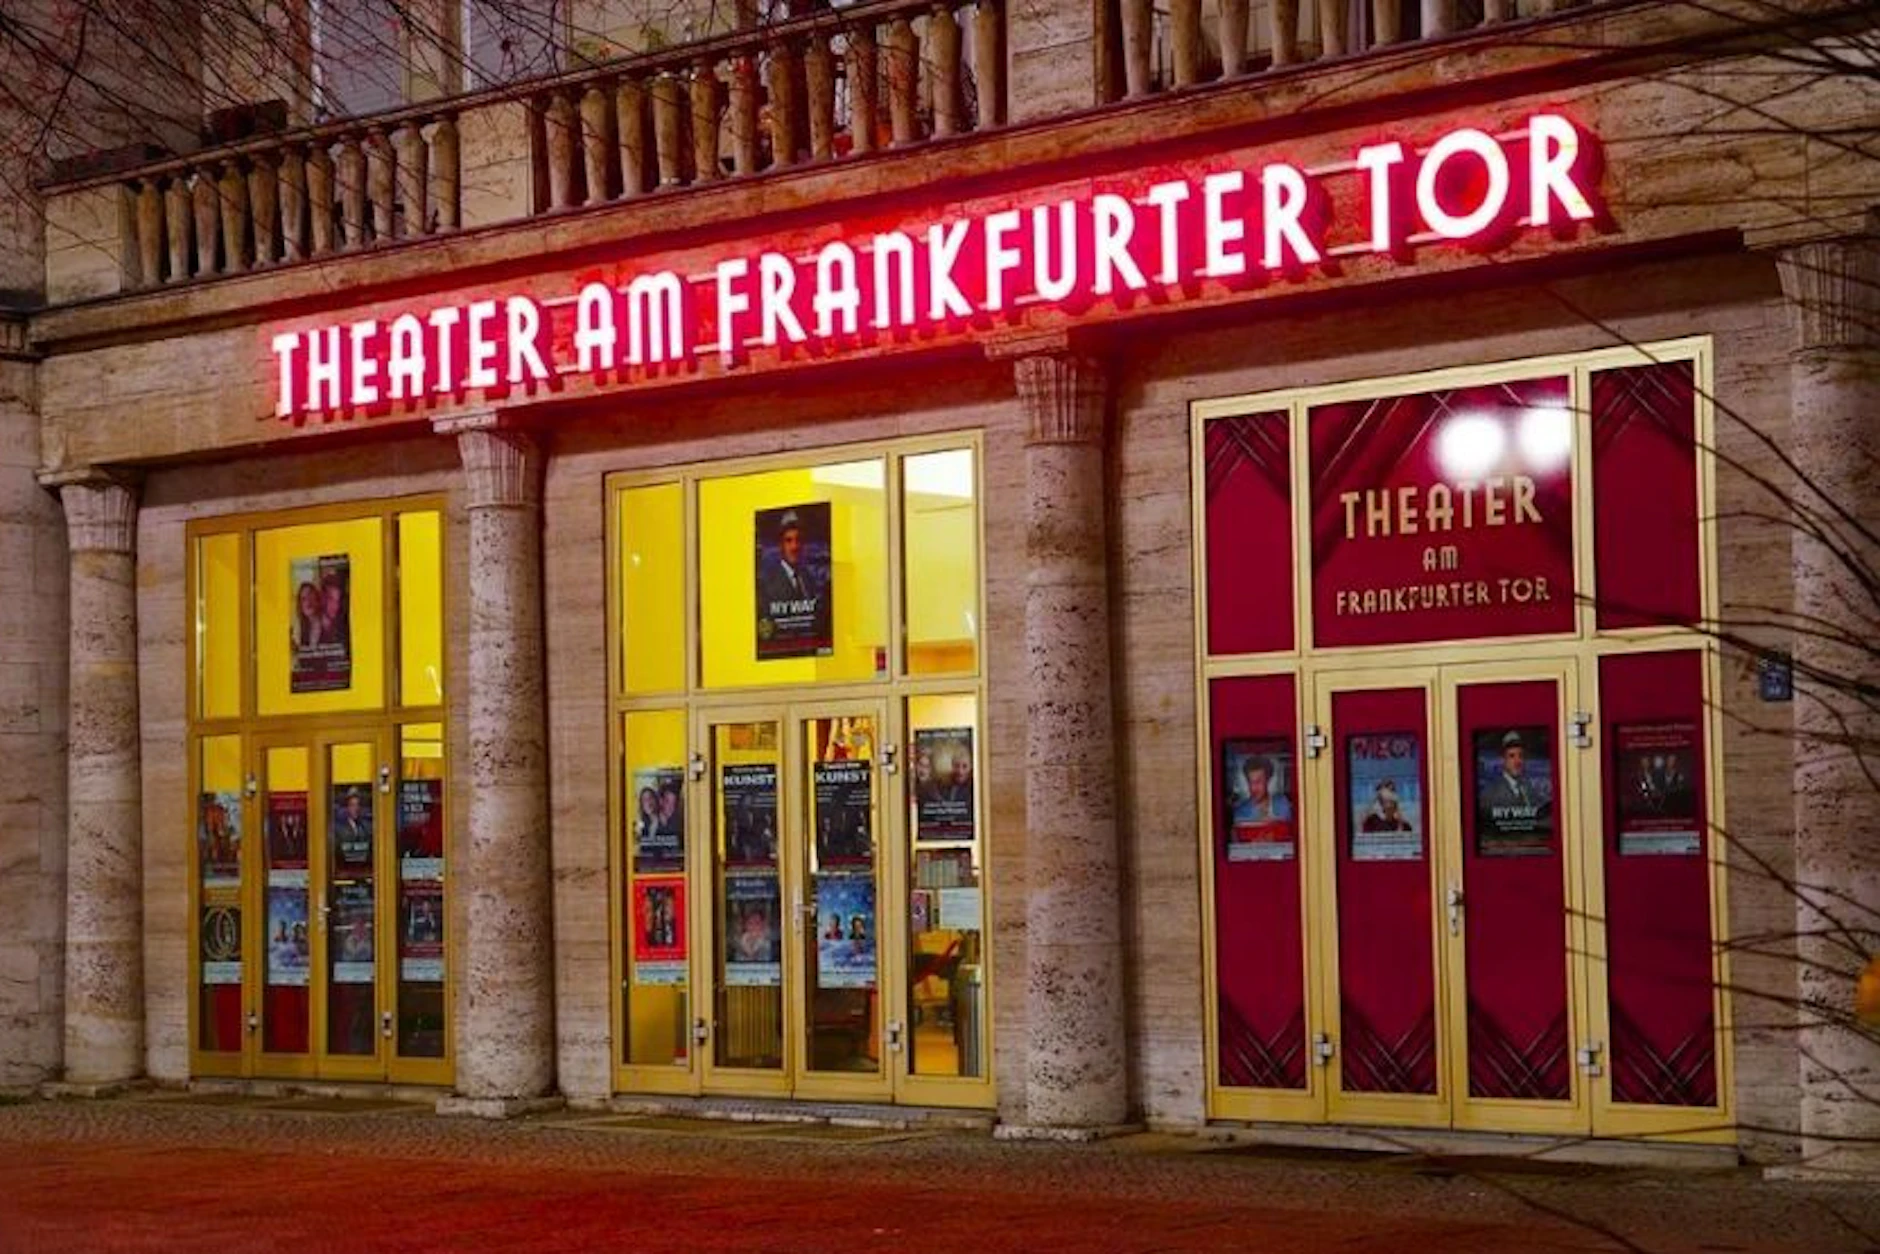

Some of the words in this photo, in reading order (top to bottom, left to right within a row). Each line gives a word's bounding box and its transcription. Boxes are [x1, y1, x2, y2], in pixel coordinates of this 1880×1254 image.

[272, 295, 549, 418] THEATER
[573, 270, 685, 372] AM
[716, 163, 1321, 365] FRANKFURTER
[1356, 113, 1595, 252] TOR
[1339, 475, 1543, 539] THEATER
[1422, 545, 1459, 571] AM
[790, 597, 818, 614] WAY
[1336, 580, 1491, 616] FRANKFURTER
[1497, 576, 1551, 603] TOR
[724, 773, 777, 786] KUNST
[815, 769, 869, 784] KUNST
